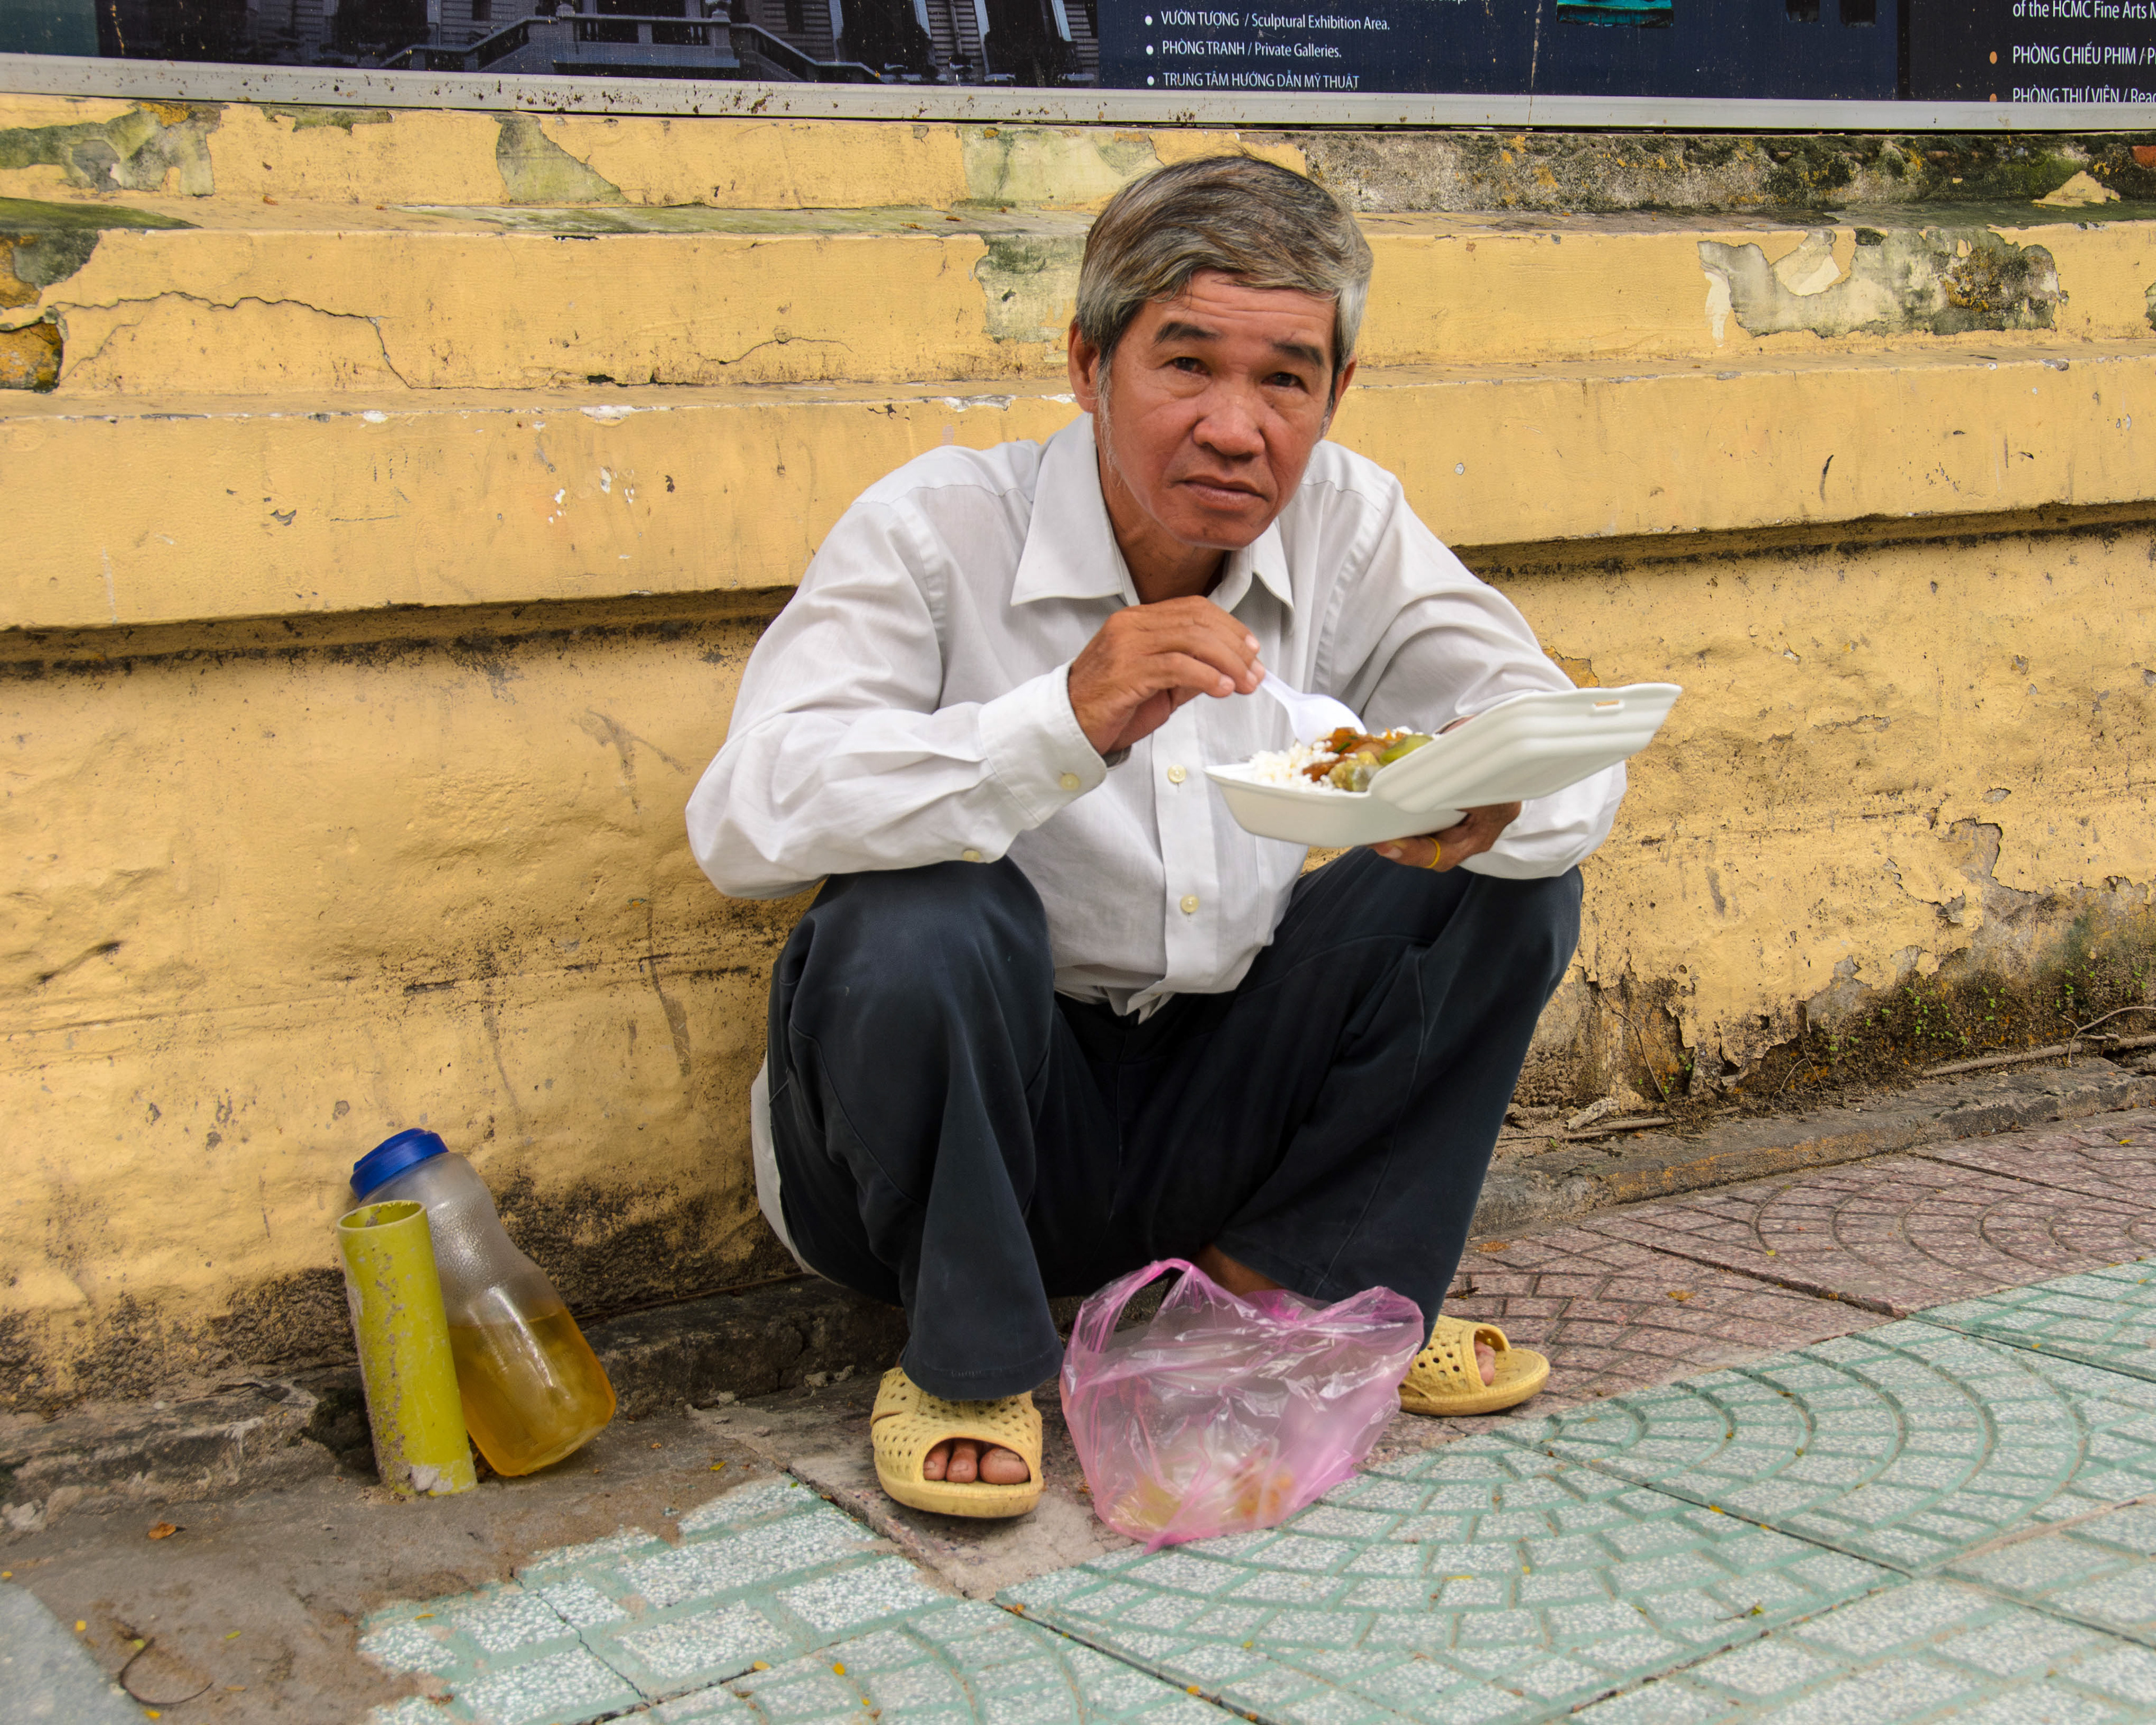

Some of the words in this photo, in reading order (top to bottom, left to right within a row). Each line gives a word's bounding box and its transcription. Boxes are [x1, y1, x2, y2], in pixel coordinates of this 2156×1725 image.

[1161, 9, 1195, 25] VƯỜN
[1197, 10, 1239, 29] TƯỢNG
[1244, 13, 1249, 27] /
[1251, 13, 1305, 30] Sculptural
[1308, 15, 1361, 29] Exhibition
[1363, 16, 1390, 30] Area.
[2013, 0, 2026, 17] of
[2029, 0, 2049, 17] the
[2053, 0, 2091, 18] HCMC
[2094, 1, 2120, 19] Fine
[2122, 1, 2147, 19] Arts
[1162, 38, 1205, 55] PHÒNG
[1206, 41, 1245, 55] TRANH
[1248, 42, 1252, 56] /
[1255, 42, 1292, 56] Private
[1294, 43, 1342, 58] Galleries.
[2013, 43, 2060, 64] PHÒNG
[2063, 41, 2101, 65] CHIẾU
[2104, 47, 2136, 65] PHIM
[2139, 47, 2145, 66] /
[1163, 72, 1203, 86] TRUNG
[1205, 70, 1229, 86] TÂM
[1231, 71, 1275, 87] HƯỚNG
[1277, 70, 1301, 88] DẪN
[1323, 73, 1359, 91] THUẬT
[2013, 84, 2059, 102] PHÒNG
[2061, 85, 2090, 102] THƯ
